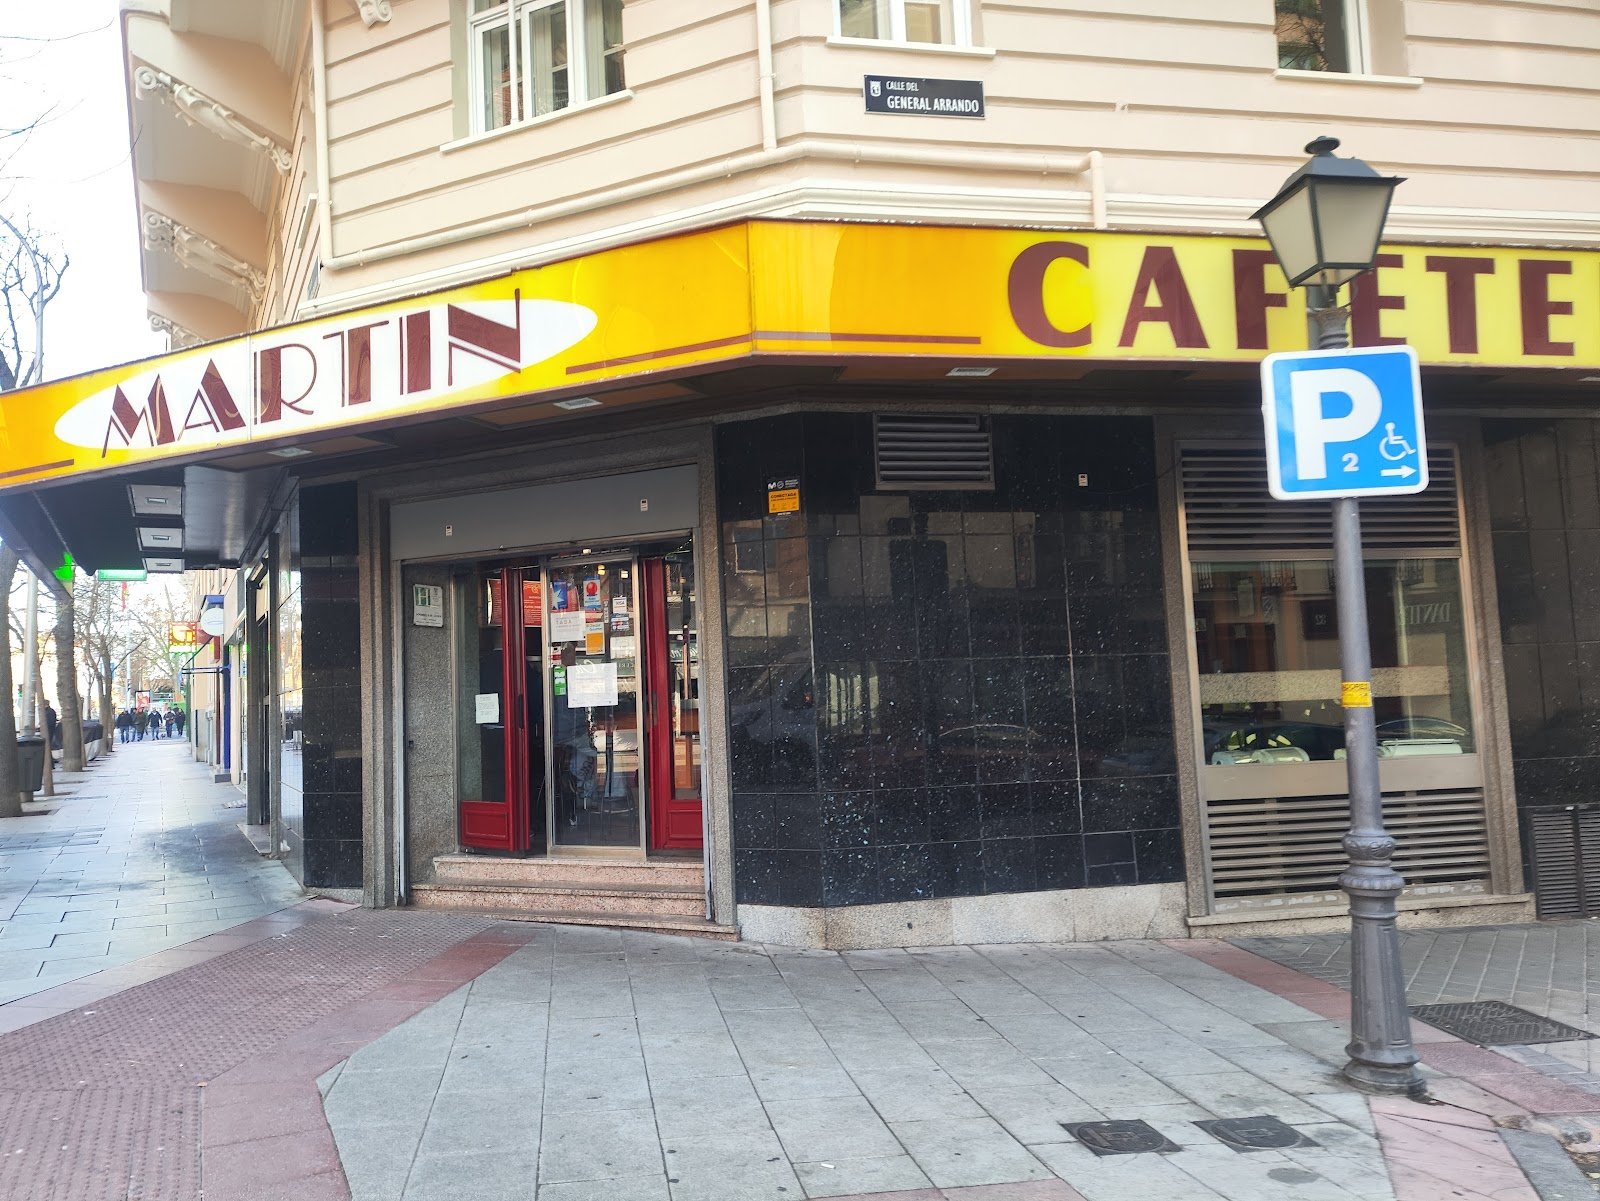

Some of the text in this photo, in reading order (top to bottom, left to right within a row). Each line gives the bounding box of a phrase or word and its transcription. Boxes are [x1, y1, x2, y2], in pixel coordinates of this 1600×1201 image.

[885, 81, 919, 91] CALLE DEL
[887, 95, 979, 112] GENERAL ARRANDO
[101, 288, 521, 458] MARTIN
[1290, 368, 1382, 480] P
[1341, 452, 1359, 472] 2
